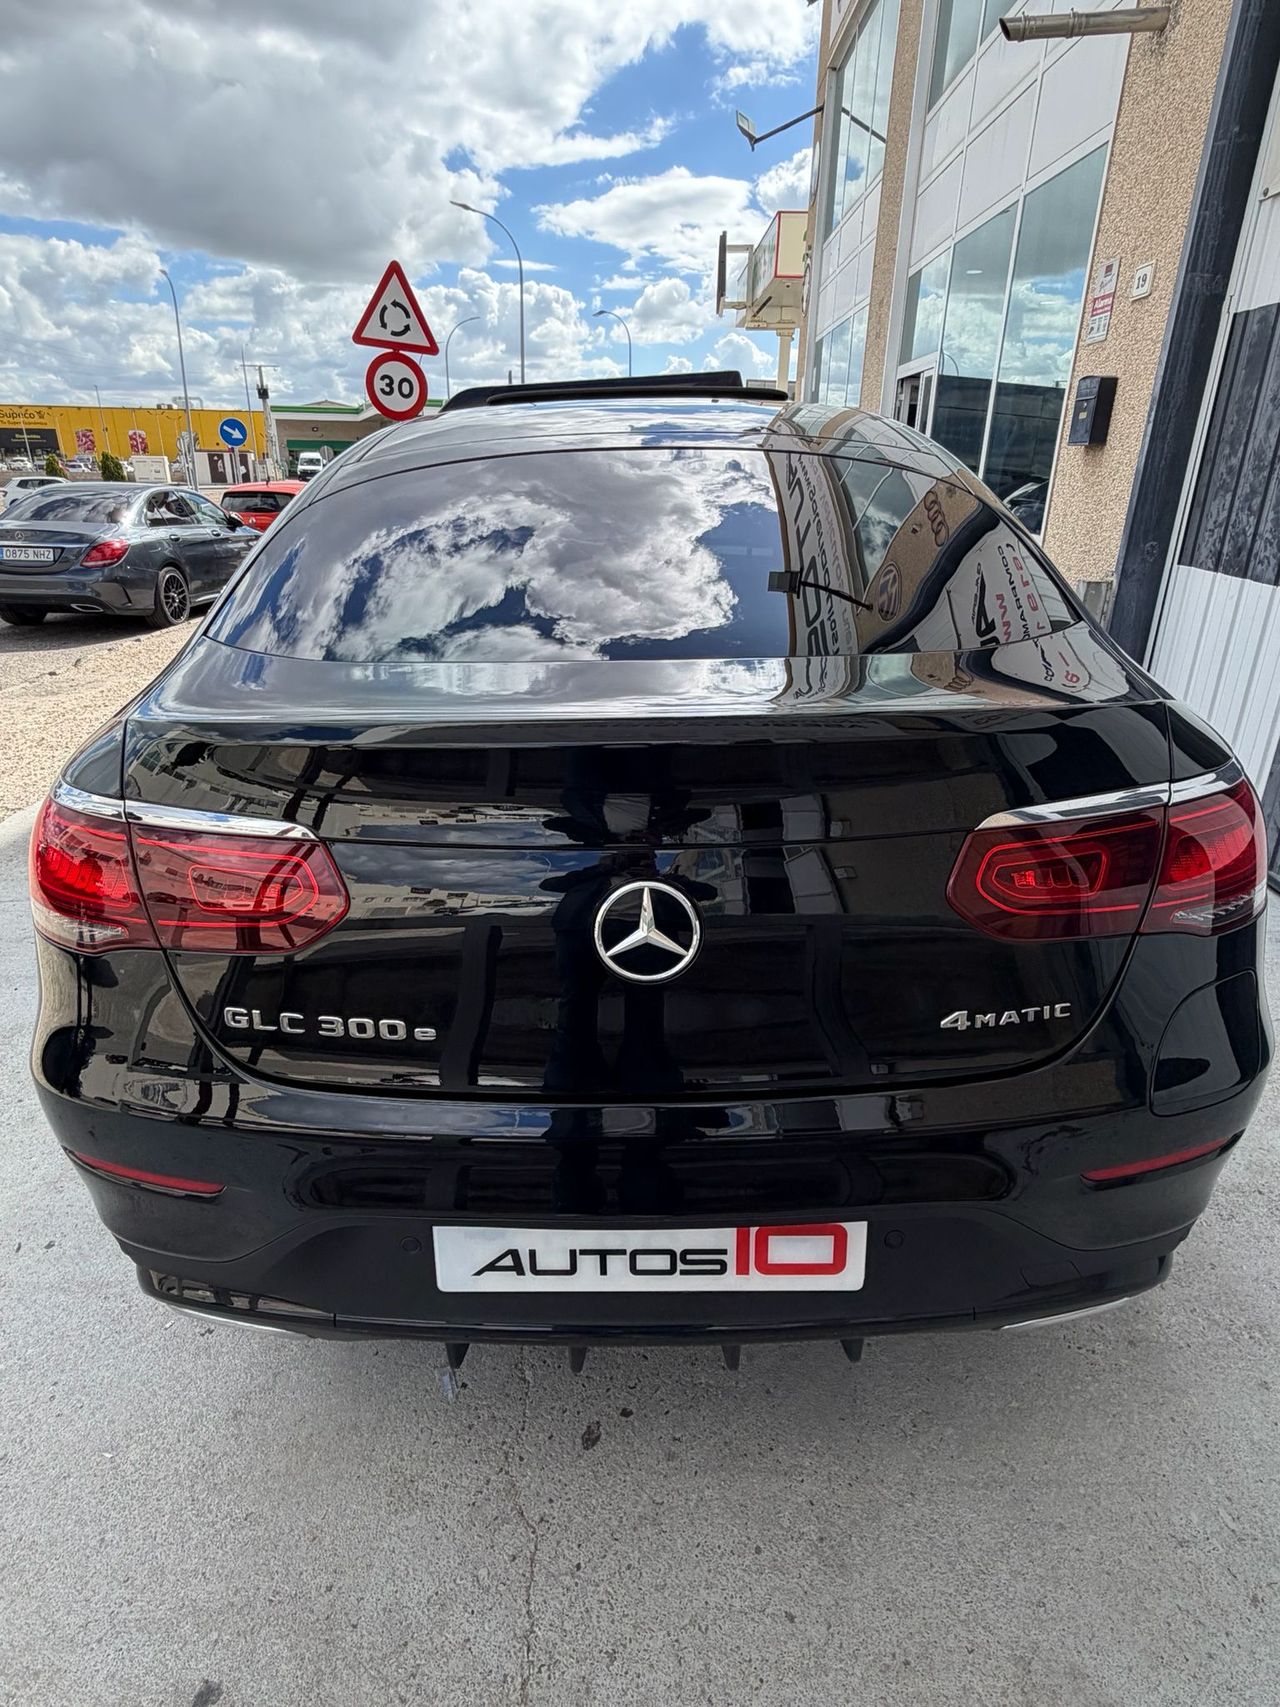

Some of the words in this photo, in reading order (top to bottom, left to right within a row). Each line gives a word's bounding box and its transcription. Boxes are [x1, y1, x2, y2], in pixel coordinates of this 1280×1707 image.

[1135, 273, 1148, 290] 19
[379, 373, 415, 400] 30
[5, 549, 30, 559] 0875
[33, 550, 52, 560] NHZ
[223, 1007, 306, 1034] GLC
[317, 1016, 408, 1041] 300
[413, 1027, 438, 1041] e
[940, 1002, 1072, 1031] 4MATIC
